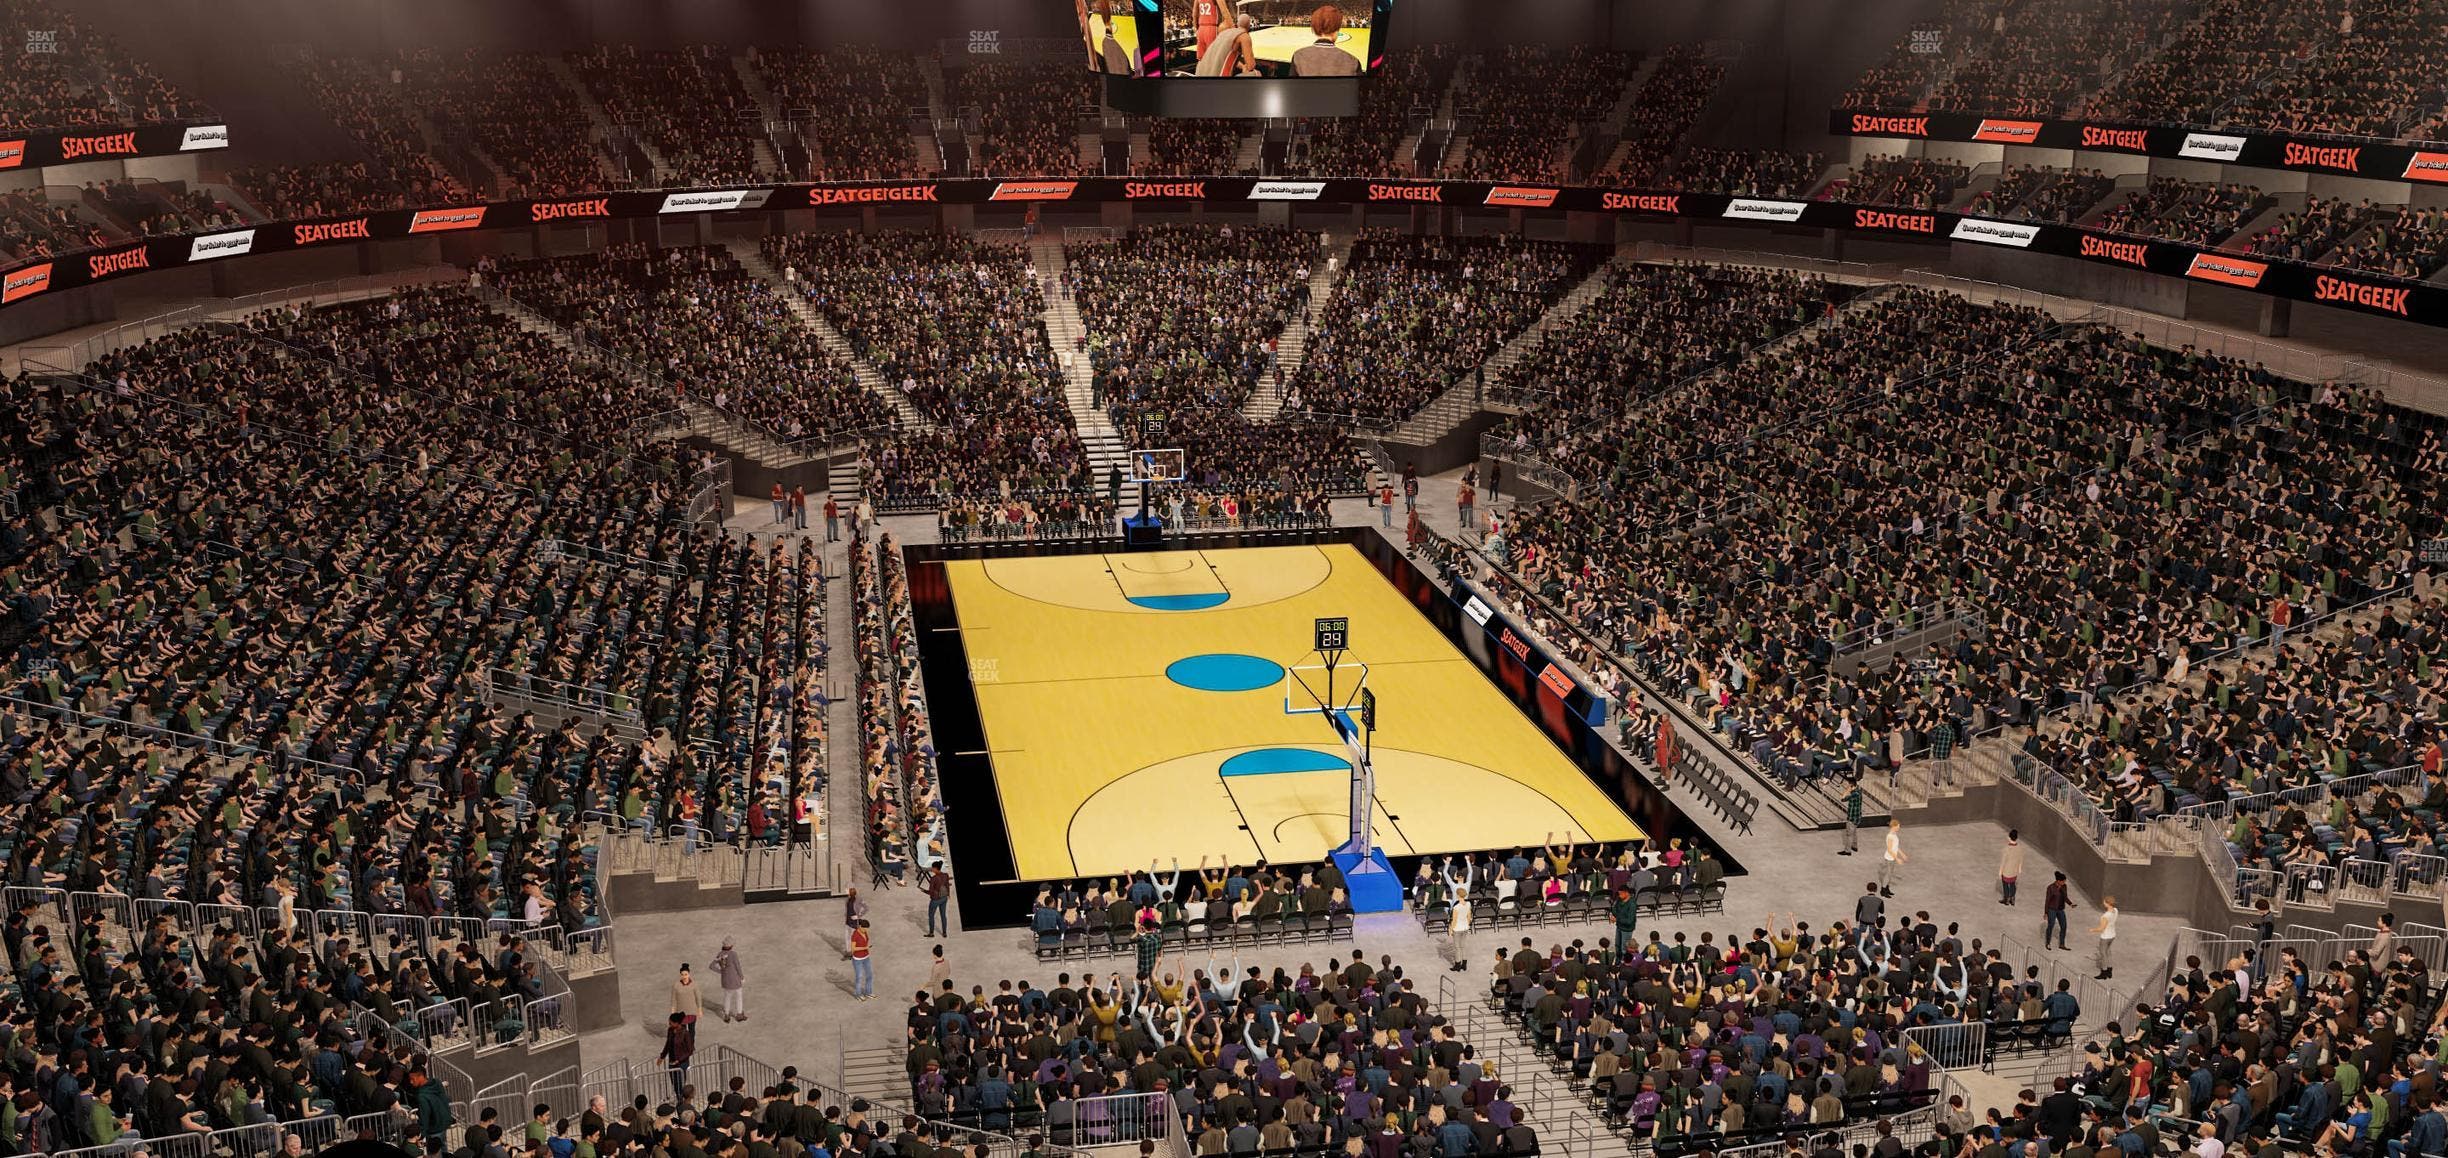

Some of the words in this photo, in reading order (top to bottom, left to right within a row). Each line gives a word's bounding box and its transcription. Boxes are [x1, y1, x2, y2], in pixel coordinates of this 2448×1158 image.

[1852, 114, 1928, 136] SEATGEEK
[2082, 126, 2147, 151] SEATGEEK
[61, 132, 138, 159] SEATGEEK
[2284, 142, 2361, 172] SEATGEEK
[1125, 182, 1205, 199] SEATGEEK
[1369, 184, 1441, 202] SEATGEEK
[1602, 193, 1679, 214] SEATGEEK
[531, 198, 610, 222] SEATGEEK
[294, 217, 370, 245] SEATGEEK
[89, 245, 150, 279] SEATGEEK
[2081, 235, 2148, 267] SEATGEEK
[2315, 275, 2410, 316] SEATGEEK
[1500, 627, 1531, 662] SEATGEEK
